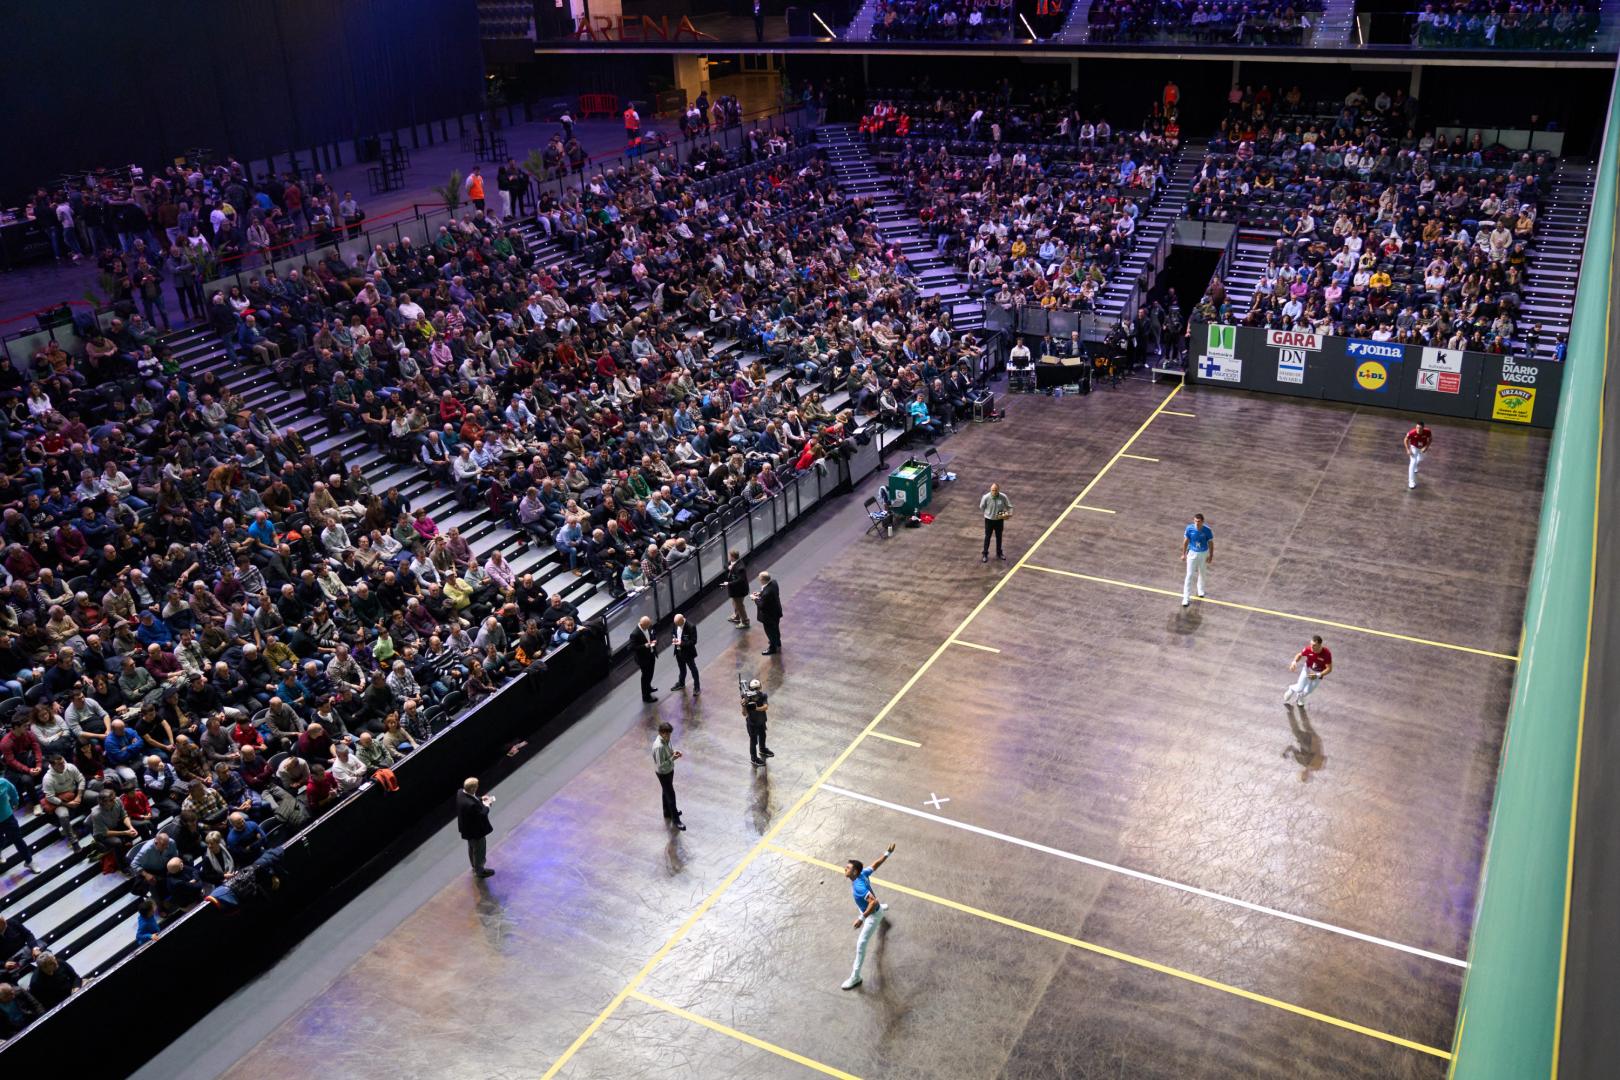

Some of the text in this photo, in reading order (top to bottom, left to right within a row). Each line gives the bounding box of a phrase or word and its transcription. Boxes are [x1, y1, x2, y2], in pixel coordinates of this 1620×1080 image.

[575, 15, 720, 41] ARENA
[1273, 331, 1316, 347] GARA
[1281, 349, 1304, 363] DN
[1503, 356, 1516, 365] EL
[1502, 364, 1539, 376] DIARIO
[1502, 372, 1536, 384] VASCO
[1501, 389, 1531, 399] URZANTE
